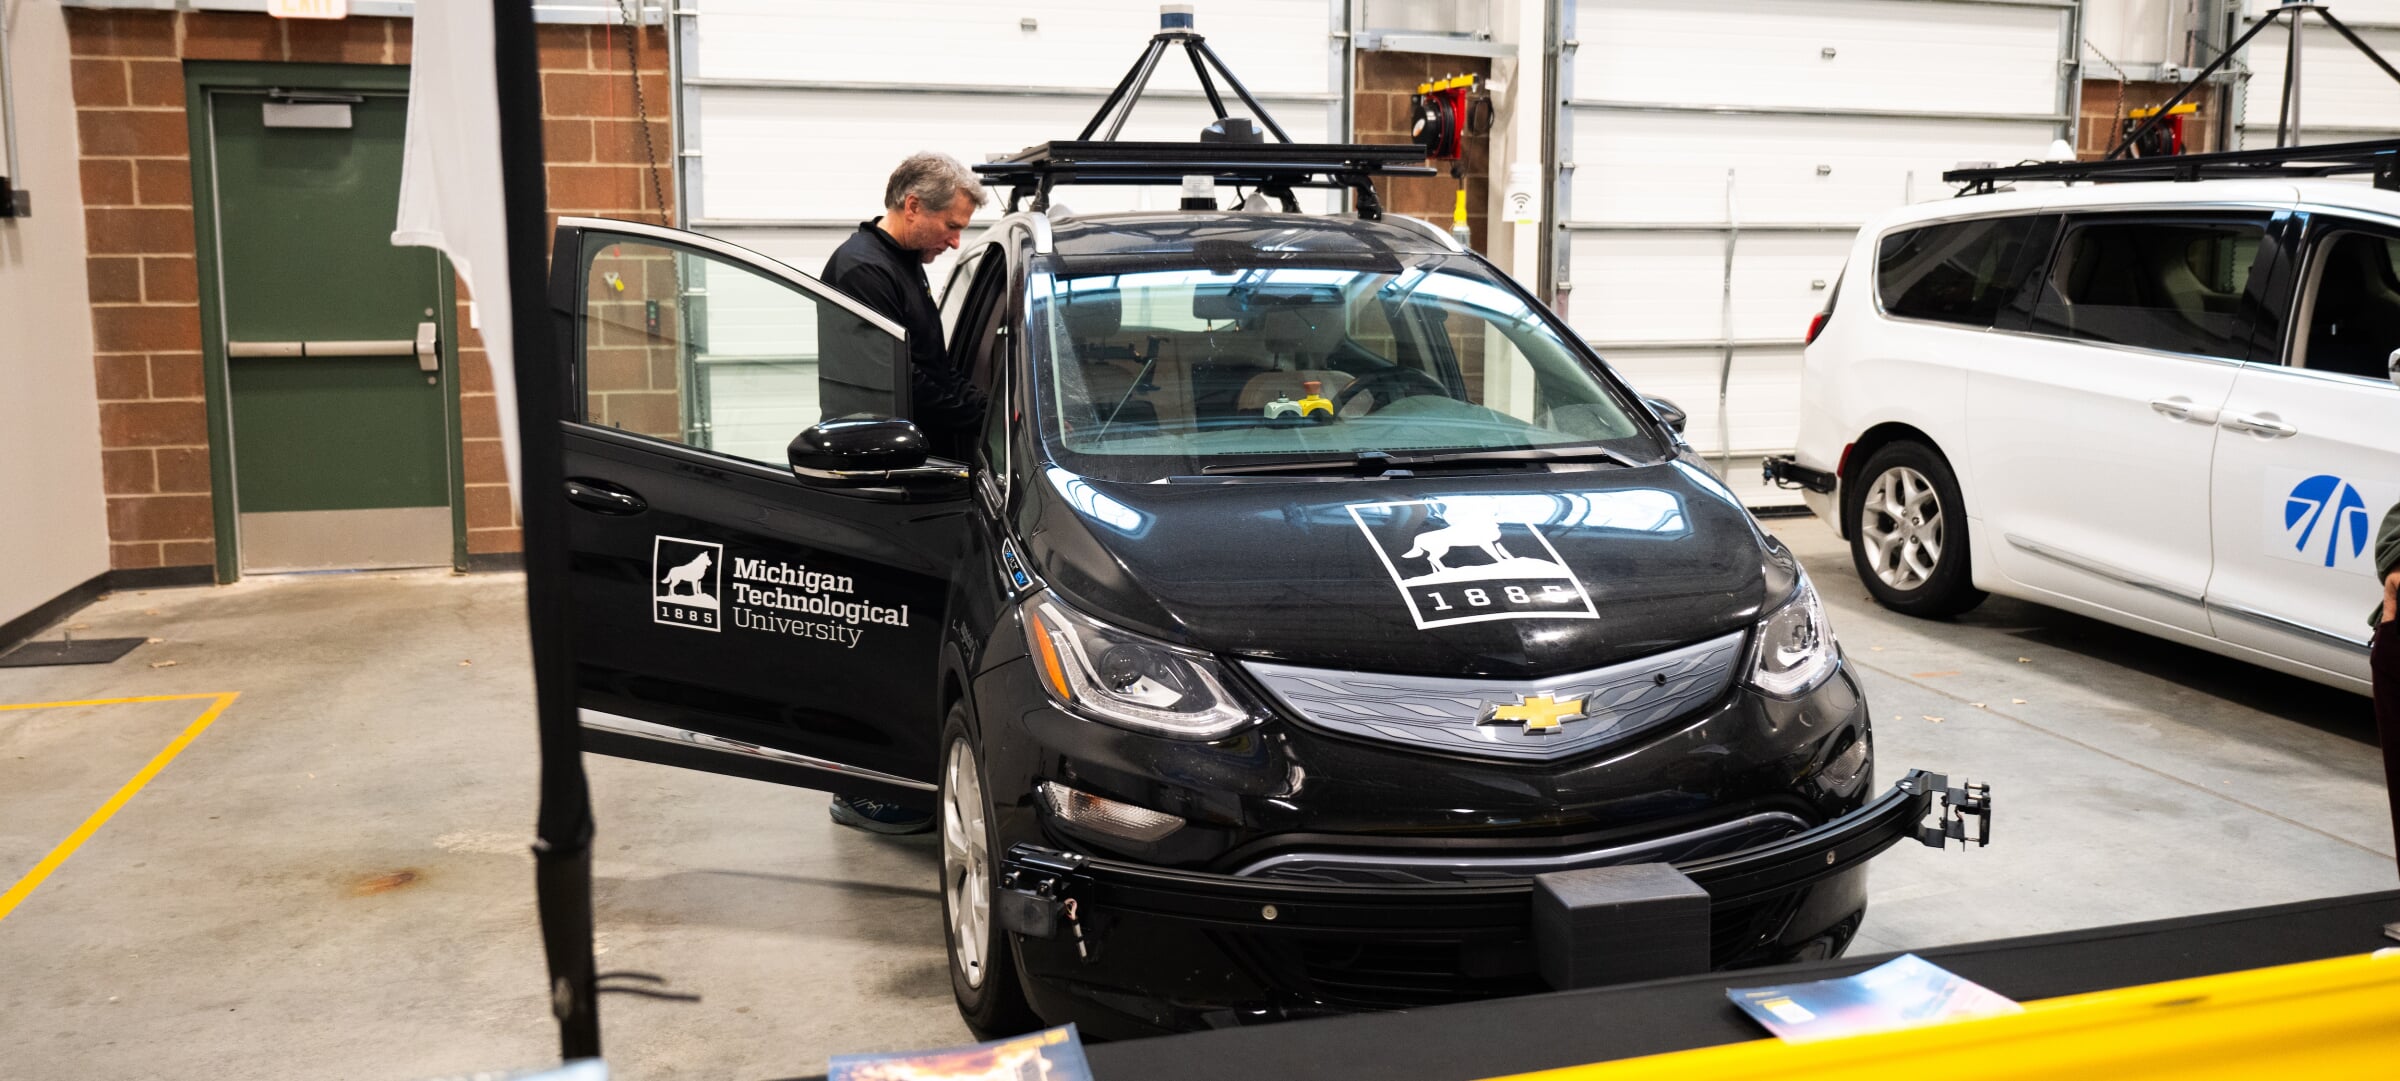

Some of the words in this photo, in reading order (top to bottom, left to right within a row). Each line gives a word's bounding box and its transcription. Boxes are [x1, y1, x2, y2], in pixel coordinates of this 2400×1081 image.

[733, 557, 854, 594] Michigan
[1014, 571, 1028, 585] EV
[732, 582, 909, 627] Technological
[1427, 586, 1570, 611] 1885
[661, 606, 713, 624] 1885
[732, 606, 863, 649] University
